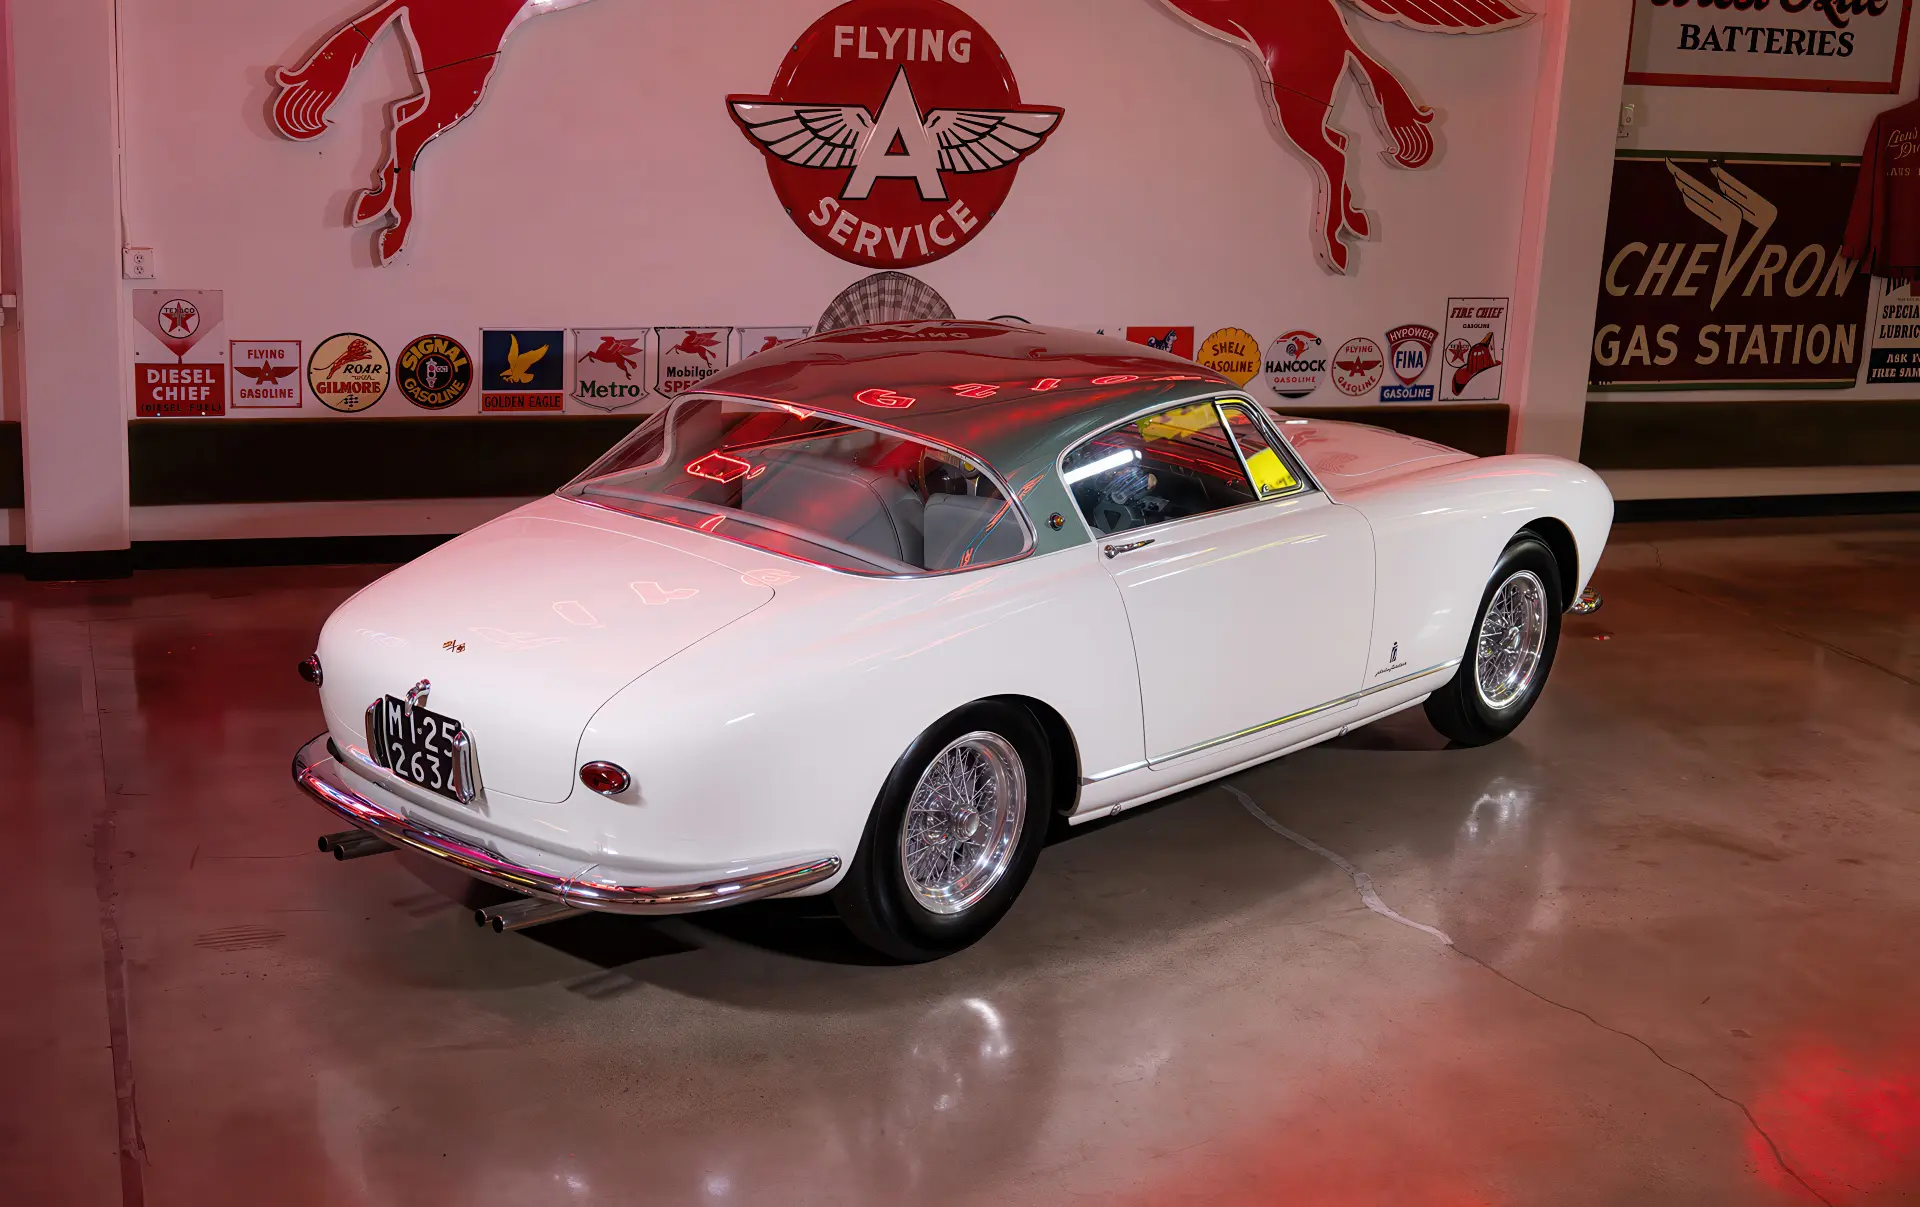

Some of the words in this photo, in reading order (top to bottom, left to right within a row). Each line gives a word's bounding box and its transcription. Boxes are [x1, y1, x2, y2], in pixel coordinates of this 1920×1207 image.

[833, 25, 972, 64] FLYING
[1677, 23, 1855, 57] BATTERIES
[808, 196, 979, 260] SERVICE
[1604, 225, 1863, 311] CHEVRON
[1450, 307, 1474, 319] FIRE
[1476, 307, 1505, 319] CHIEF
[1390, 327, 1435, 342] HYPOWER
[1212, 341, 1246, 357] SHELL
[1345, 345, 1373, 354] FLYING
[1593, 323, 1681, 366] GAS
[1696, 324, 1857, 365] STATION
[247, 349, 285, 359] FLYING
[402, 339, 468, 372] SIGNAL
[1395, 350, 1424, 369] FINA
[343, 364, 383, 374] ROAR
[1204, 360, 1254, 373] GASOLINE
[1265, 359, 1327, 373] HANCOCK
[147, 369, 216, 384] DIESEL
[1274, 376, 1316, 384] GASOLINE
[1337, 375, 1377, 393] GASOLINE
[152, 386, 211, 401] CHIEF
[240, 388, 294, 399] GASOLINE
[316, 381, 381, 395] GILMORE
[404, 378, 465, 404] GASOLINE
[578, 380, 640, 398] Metro
[1383, 387, 1431, 399] GASOLINE
[484, 396, 525, 408] GOLDEN
[529, 396, 562, 408] EAGLE
